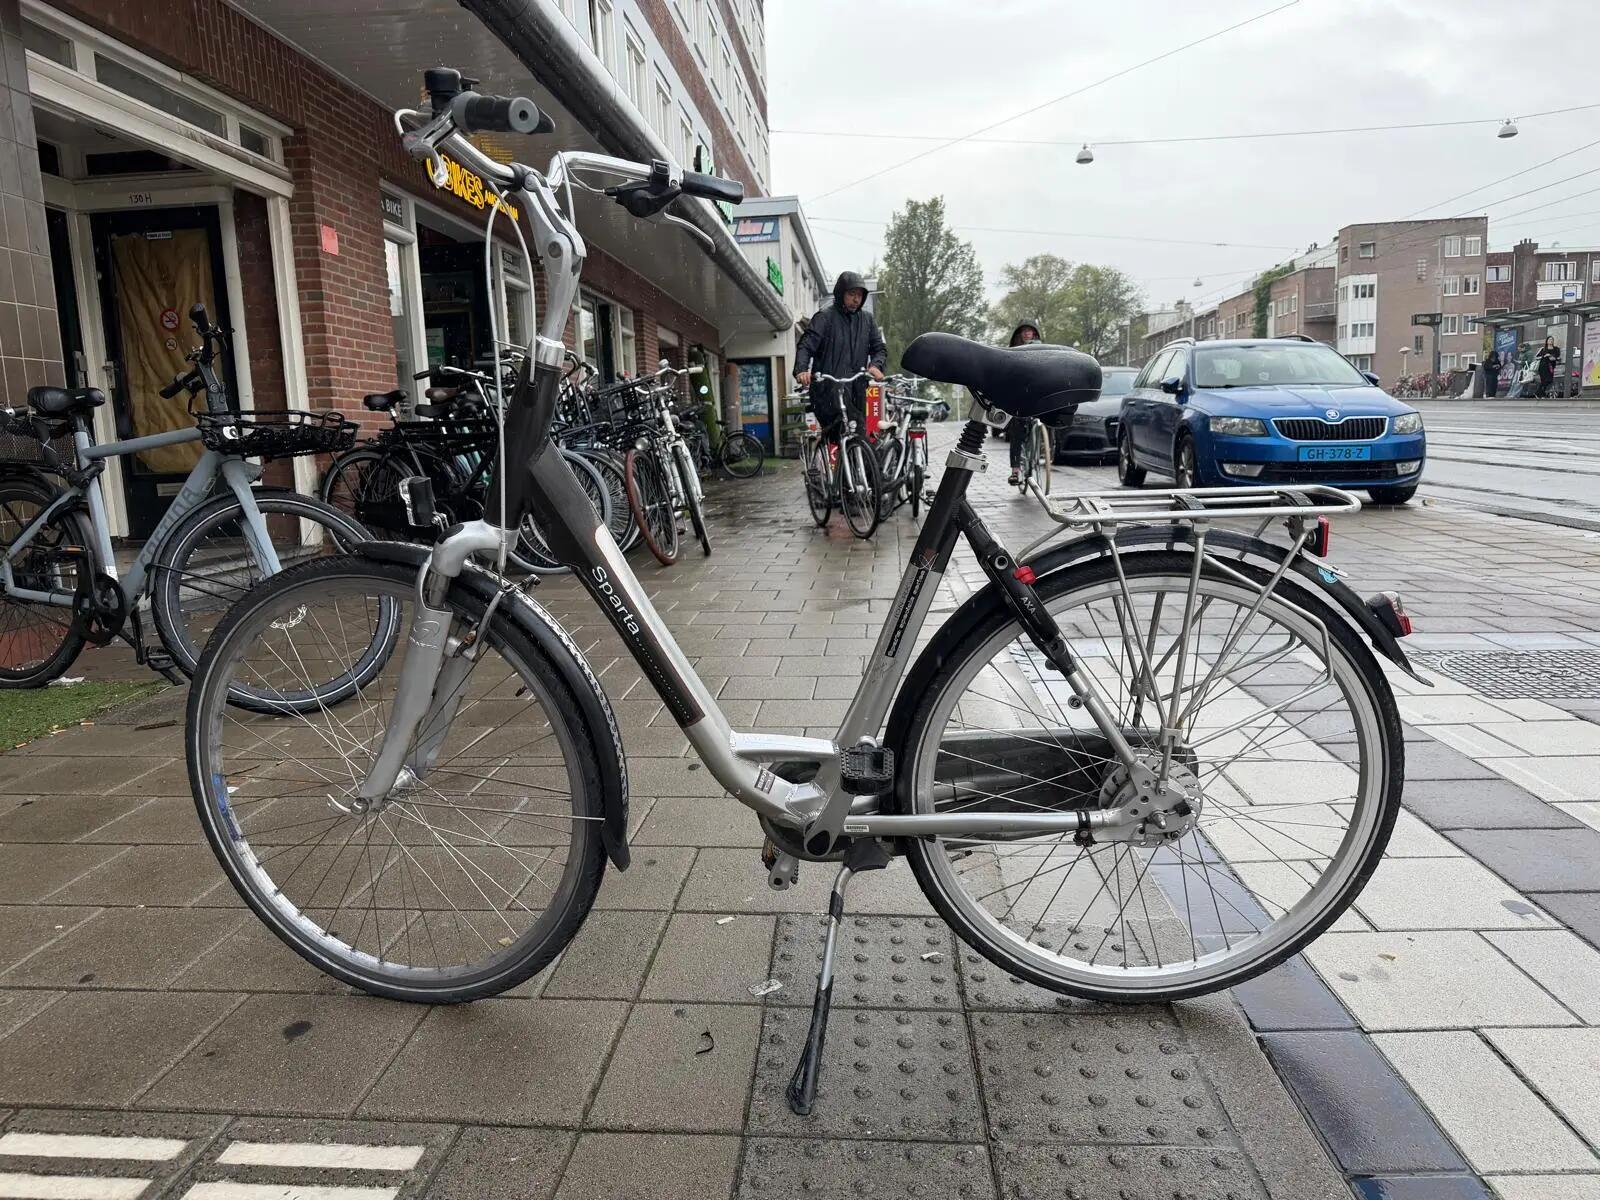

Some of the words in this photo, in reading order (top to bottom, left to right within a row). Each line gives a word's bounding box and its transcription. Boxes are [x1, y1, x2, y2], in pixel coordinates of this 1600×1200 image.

[129, 194, 144, 204] 130
[385, 198, 402, 217] BIKE
[1306, 448, 1363, 459] GH-378-Z
[592, 566, 640, 636] Sparta
[1020, 596, 1036, 615] AXA
